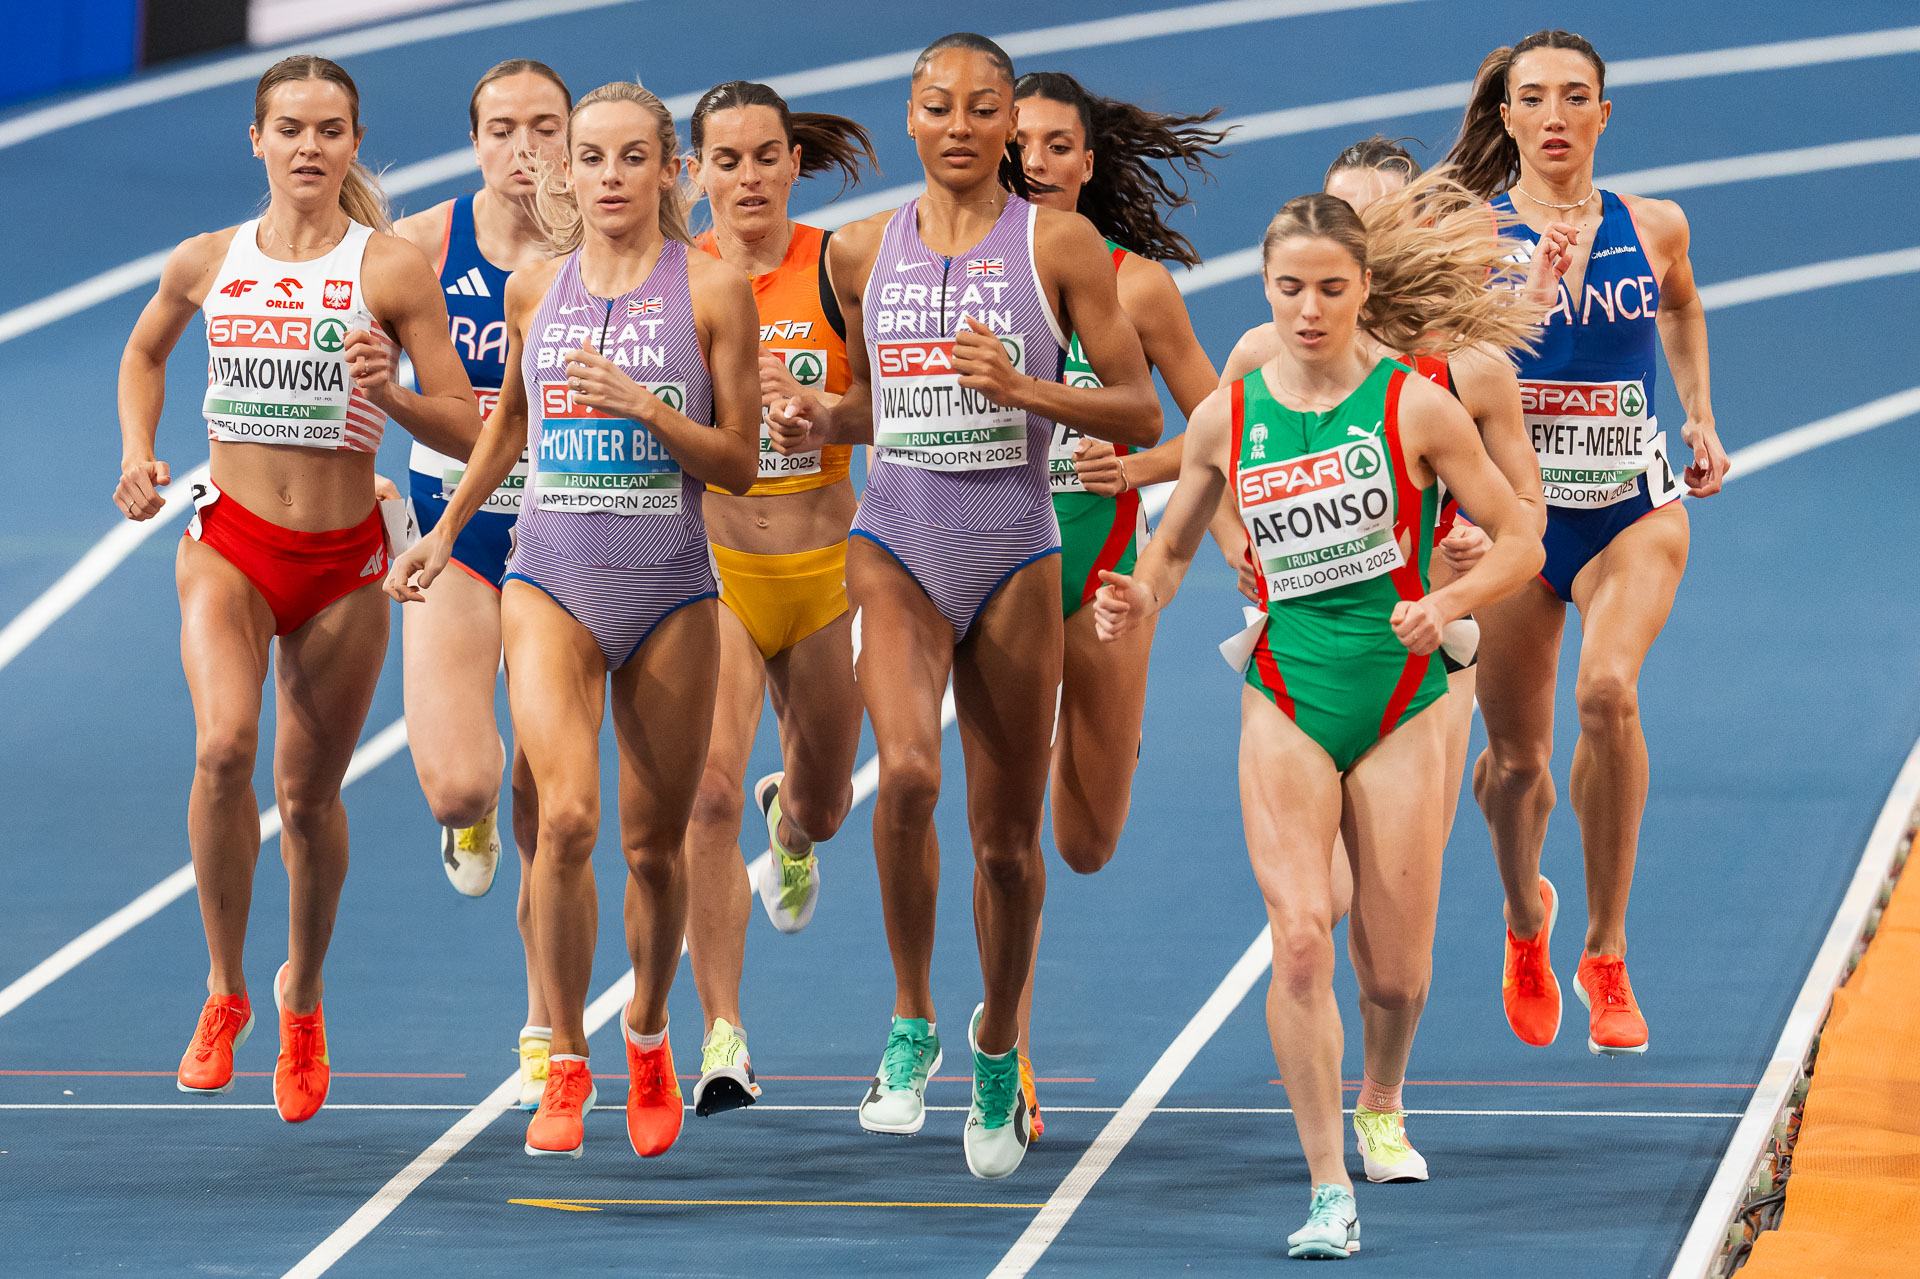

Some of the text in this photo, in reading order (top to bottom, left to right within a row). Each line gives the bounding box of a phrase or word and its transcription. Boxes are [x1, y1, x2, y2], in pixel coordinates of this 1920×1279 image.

[220, 279, 259, 298] 4F
[880, 281, 1009, 308] GREAT
[265, 299, 304, 310] ORLEN
[210, 319, 308, 346] SPAR
[542, 318, 665, 347] GREAT
[877, 309, 1012, 335] BRITAIN
[537, 345, 665, 369] BRAIN
[880, 346, 955, 373] SPA
[229, 403, 232, 413] I
[234, 404, 261, 415] RUN
[882, 385, 1021, 419] WALCOTT-NO
[1520, 386, 1615, 412] SPAR
[303, 425, 340, 440] 2025
[540, 429, 625, 462] HUNTER
[632, 429, 673, 462] BEL
[906, 435, 910, 446] I
[912, 433, 941, 446] RUN
[1531, 424, 1643, 457] EYET-MERLE
[780, 456, 816, 471] 2025
[986, 446, 1023, 462] 2025
[564, 475, 569, 487] I
[571, 476, 600, 488] RUN
[1242, 457, 1342, 503] SPAR
[1542, 468, 1572, 482] RUN
[542, 493, 678, 509] APELDOORN 2025
[1252, 487, 1388, 547] AFONSO
[360, 542, 384, 578] 4F
[1272, 547, 1397, 594] APELDOORN 2025
[1294, 553, 1319, 568] RUN
